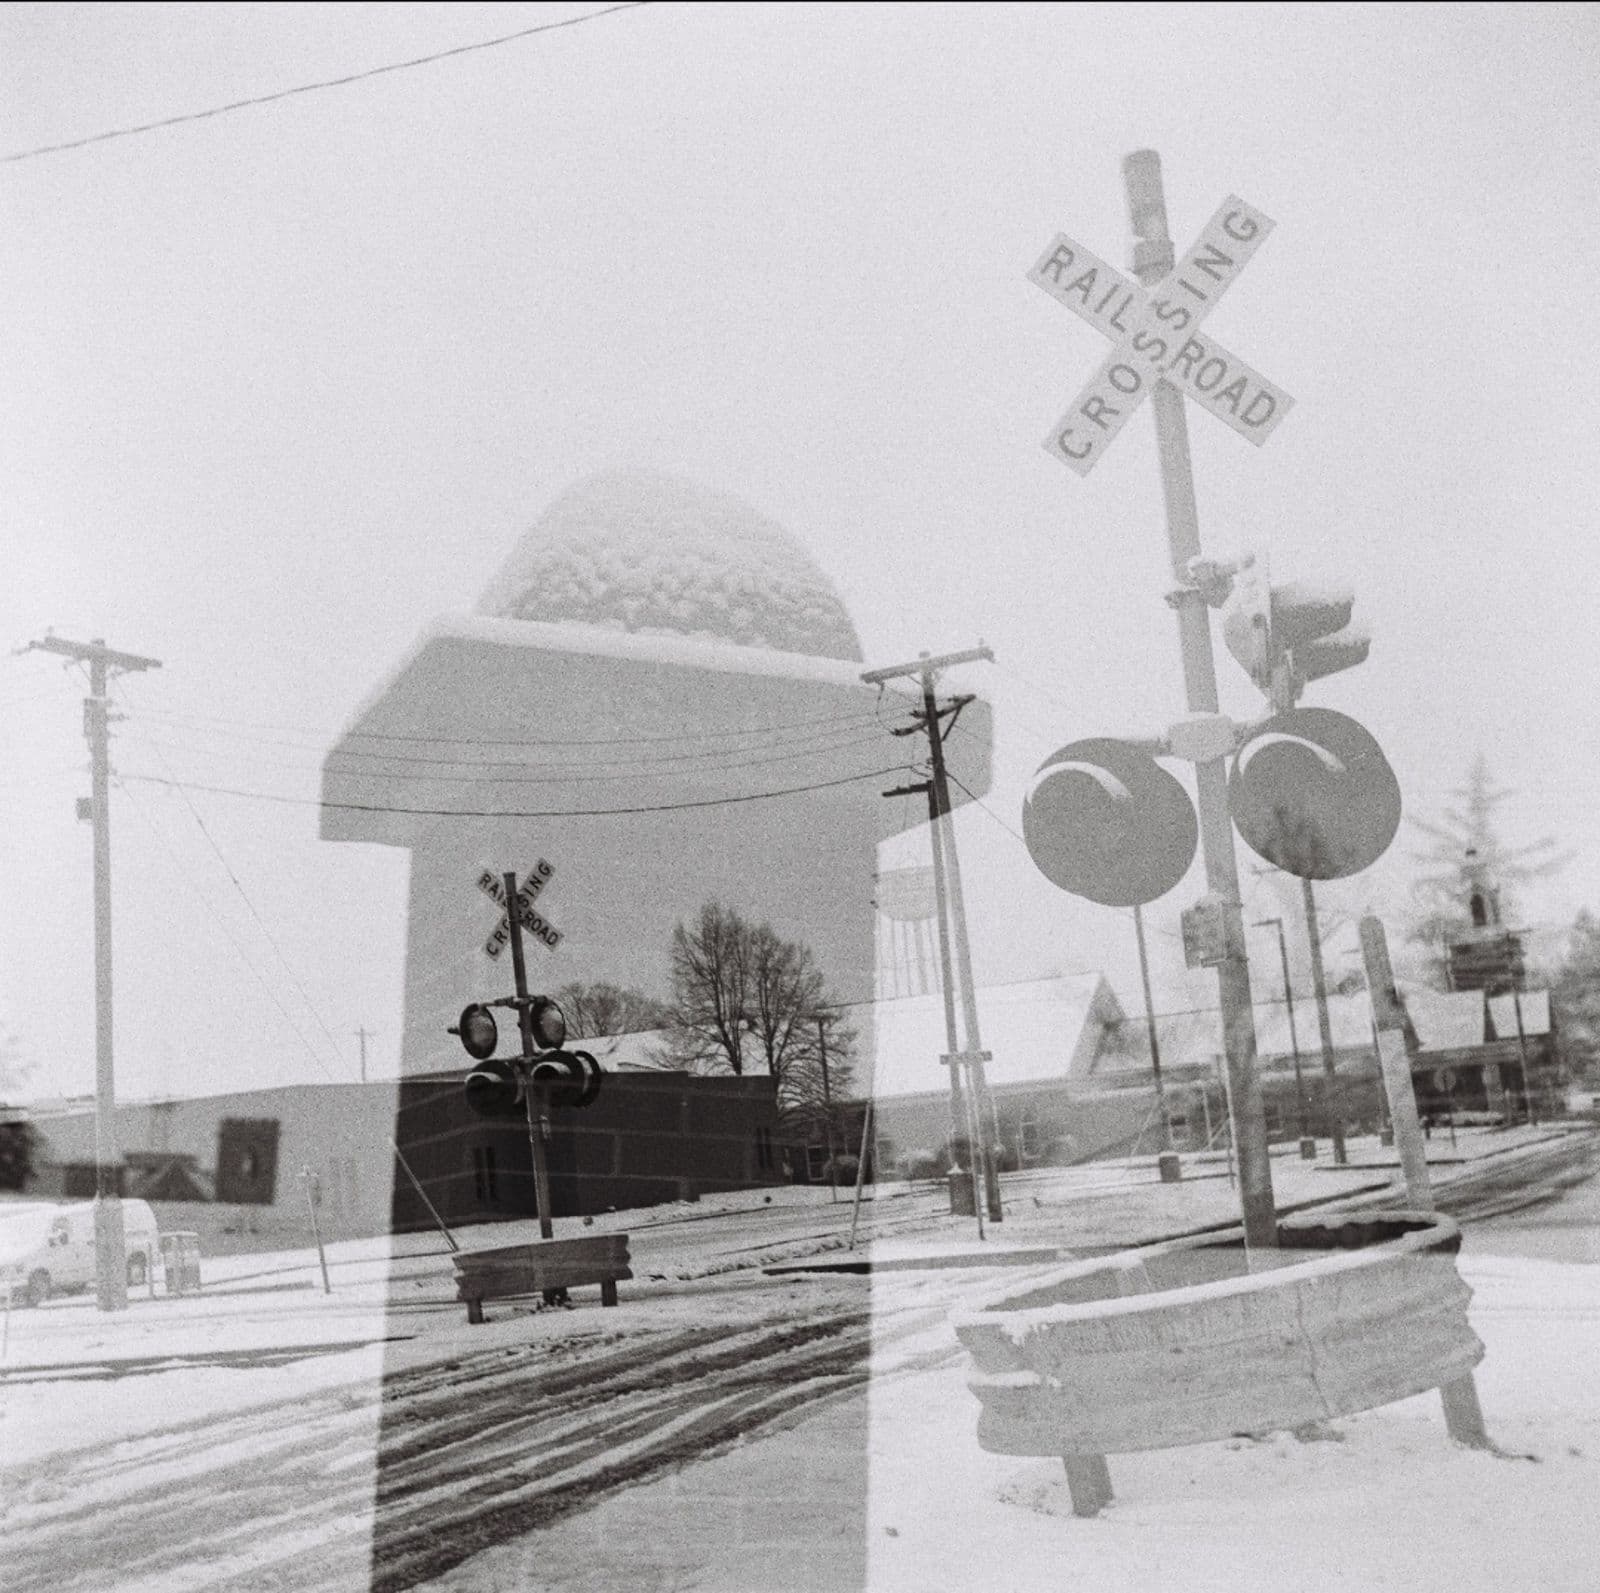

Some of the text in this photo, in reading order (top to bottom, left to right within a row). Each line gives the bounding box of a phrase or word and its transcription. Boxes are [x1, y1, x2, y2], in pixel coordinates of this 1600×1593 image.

[1040, 244, 1277, 428] RAIL ROAD
[1058, 211, 1258, 460] CROSSING
[479, 873, 559, 946] RAI ROAD
